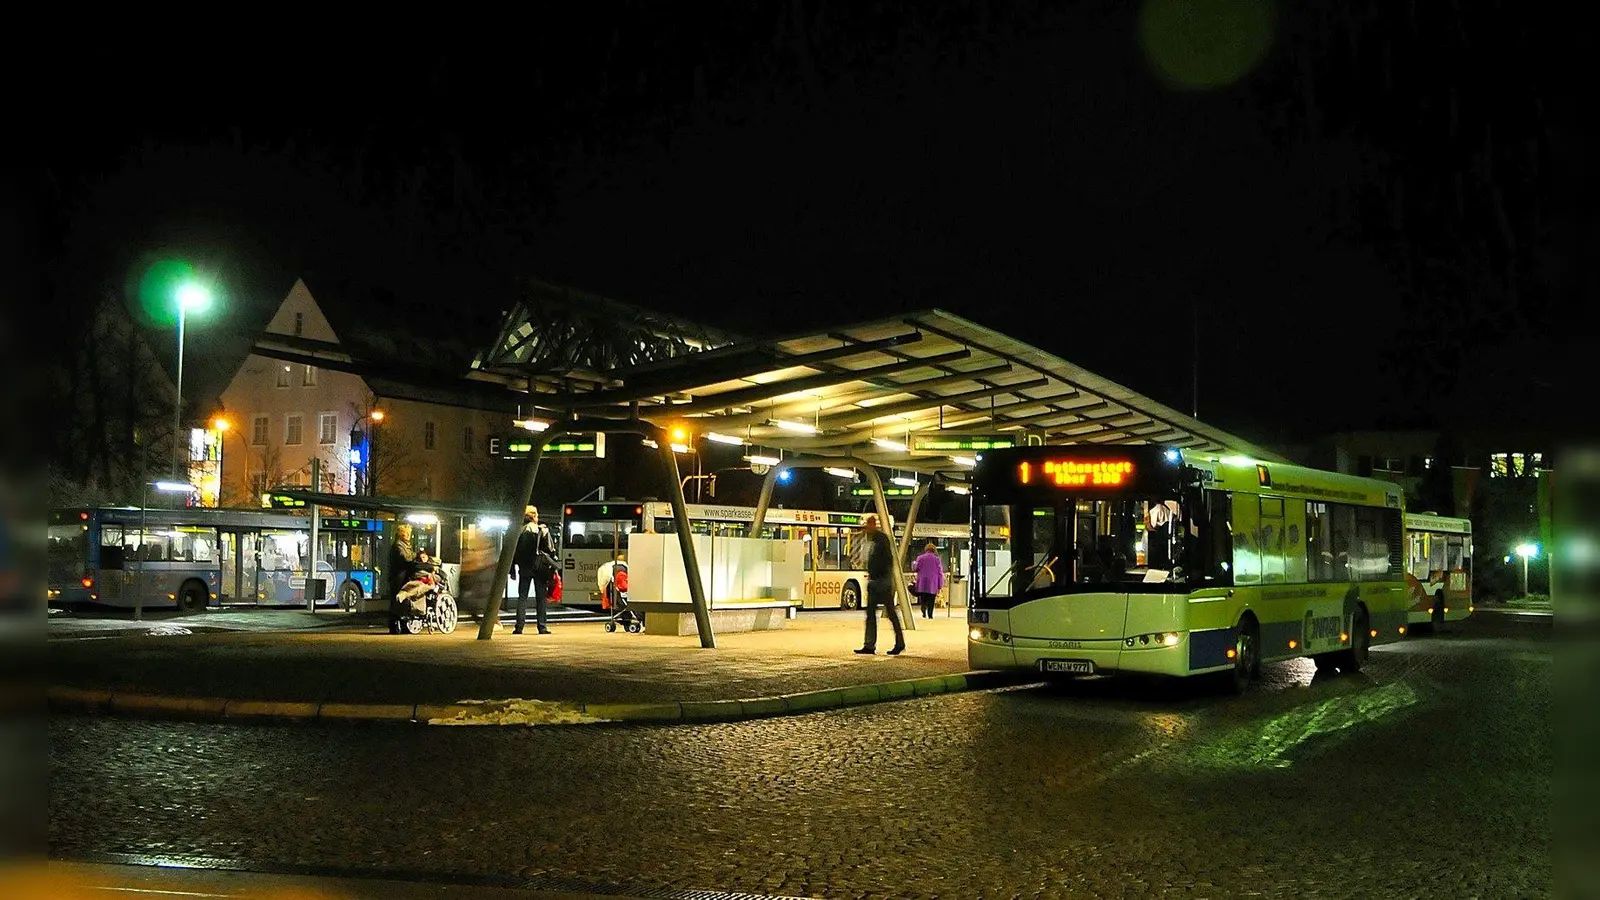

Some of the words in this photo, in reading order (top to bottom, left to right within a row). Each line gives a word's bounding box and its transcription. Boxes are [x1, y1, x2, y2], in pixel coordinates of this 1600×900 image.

[490, 439, 500, 454] E
[1021, 462, 1029, 484] 1
[837, 485, 844, 497] F
[602, 505, 608, 515] 3
[1048, 641, 1082, 649] SOLARIS
